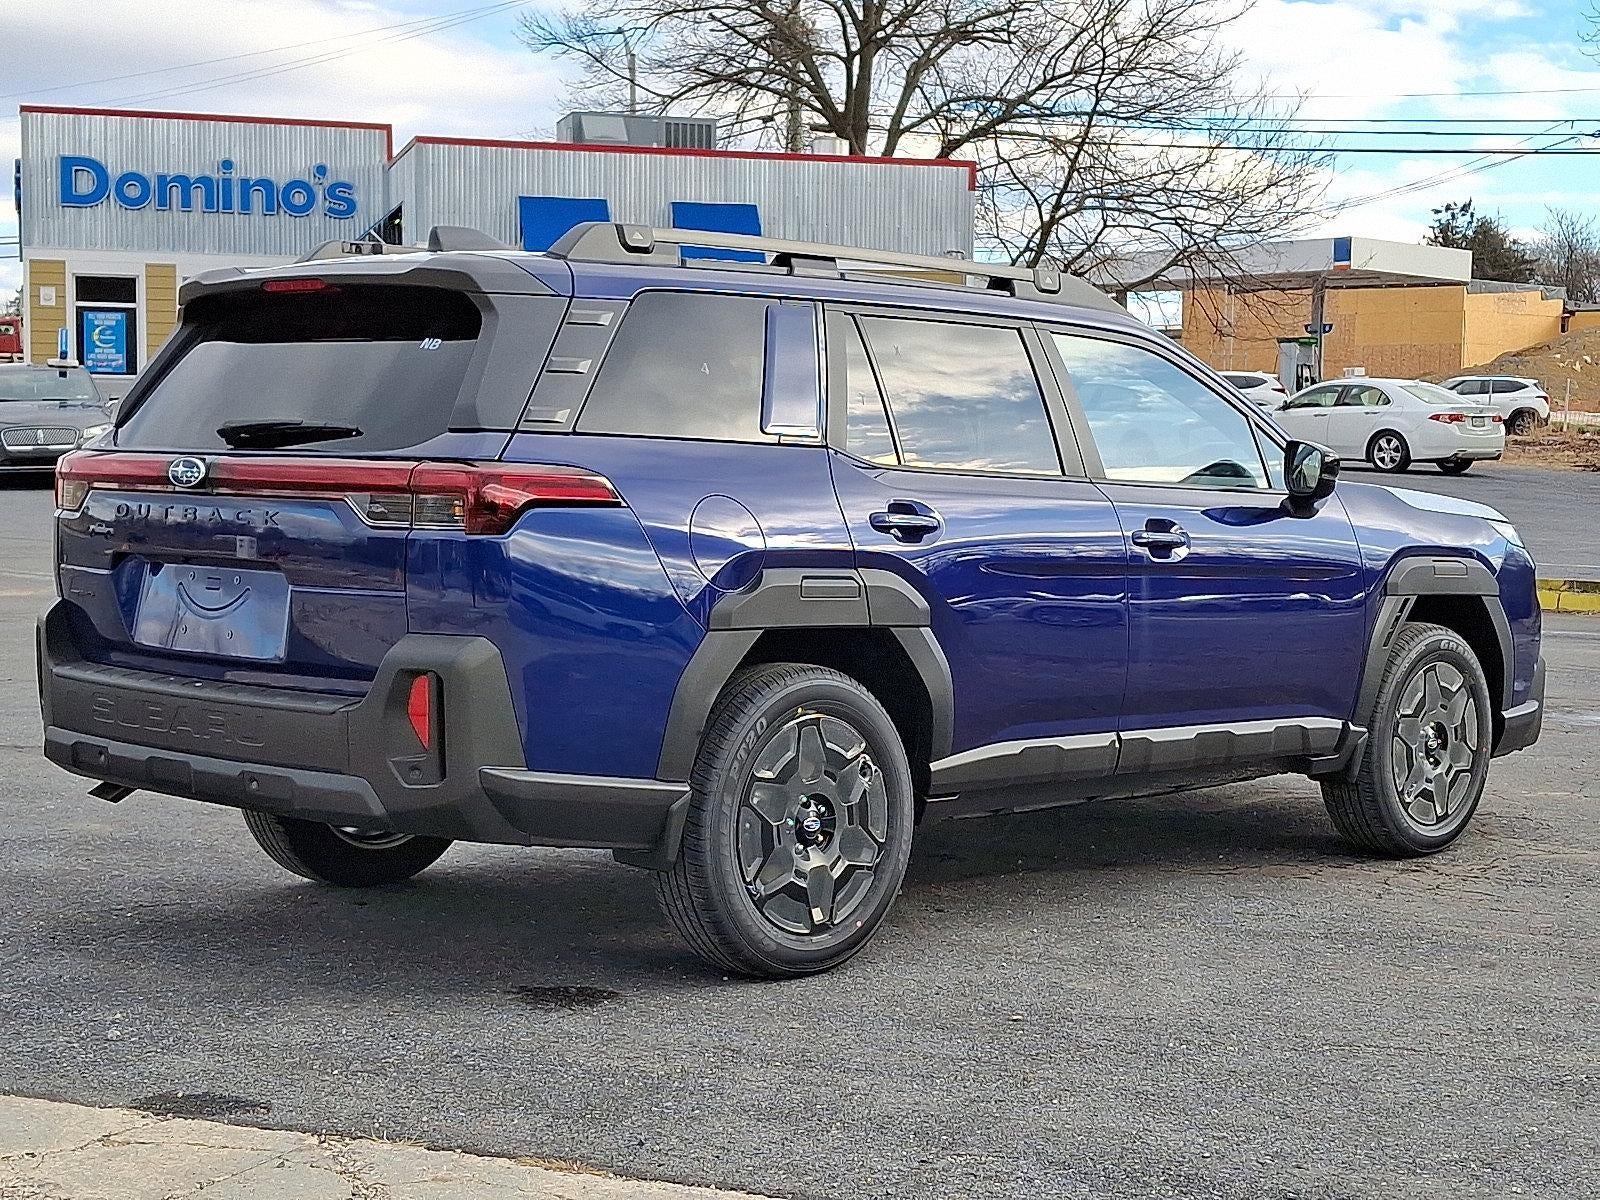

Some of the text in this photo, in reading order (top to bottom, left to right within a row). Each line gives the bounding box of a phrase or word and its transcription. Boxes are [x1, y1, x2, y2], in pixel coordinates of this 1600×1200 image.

[59, 154, 358, 219] Domino's
[419, 337, 442, 350] NB
[115, 502, 280, 527] OUTBACK
[92, 691, 266, 747] SUBARU
